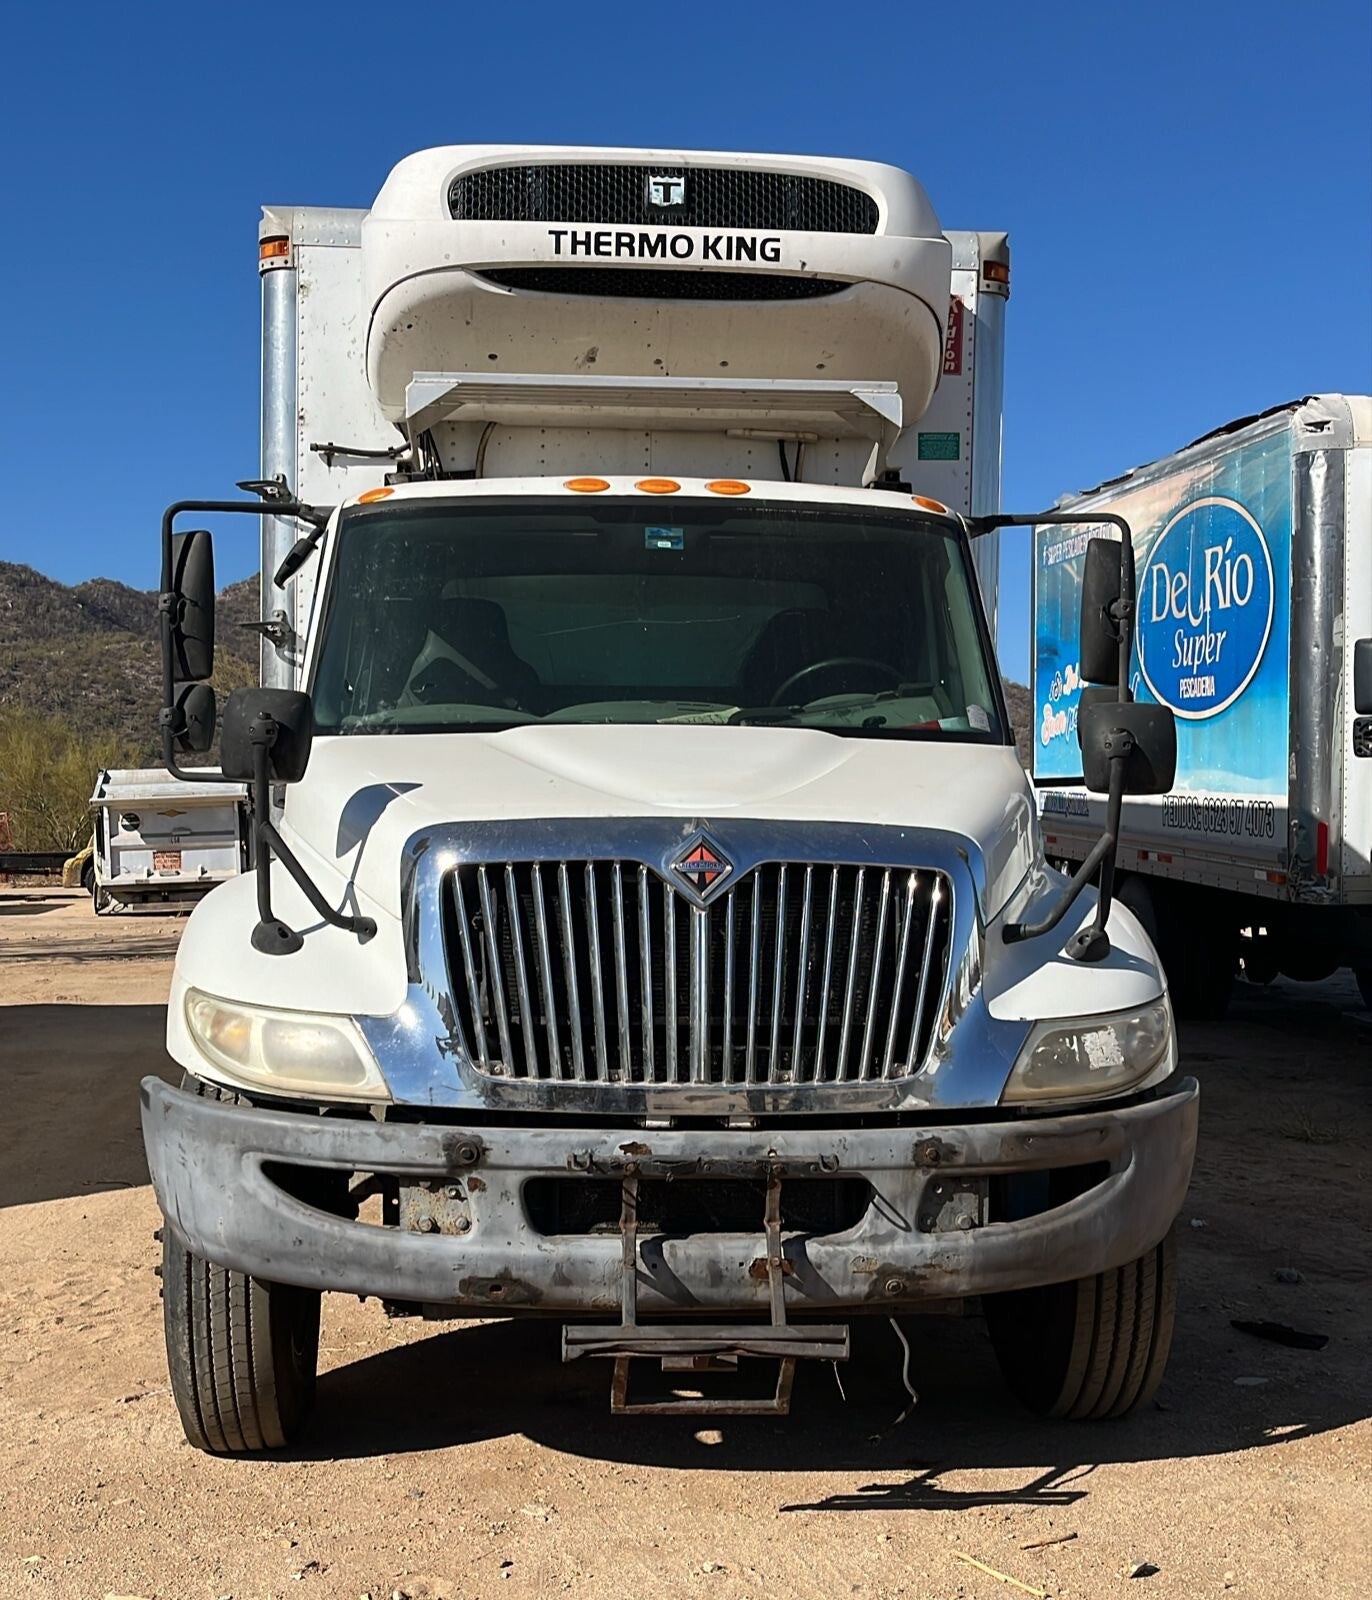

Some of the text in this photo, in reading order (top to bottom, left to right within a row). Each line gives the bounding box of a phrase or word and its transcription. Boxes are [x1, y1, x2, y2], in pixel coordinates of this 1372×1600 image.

[548, 229, 781, 263] THERMO KING
[1203, 536, 1254, 613] Río
[1172, 628, 1227, 675] Super
[1162, 795, 1275, 838] PEDIDOS: 6623 97 4073
